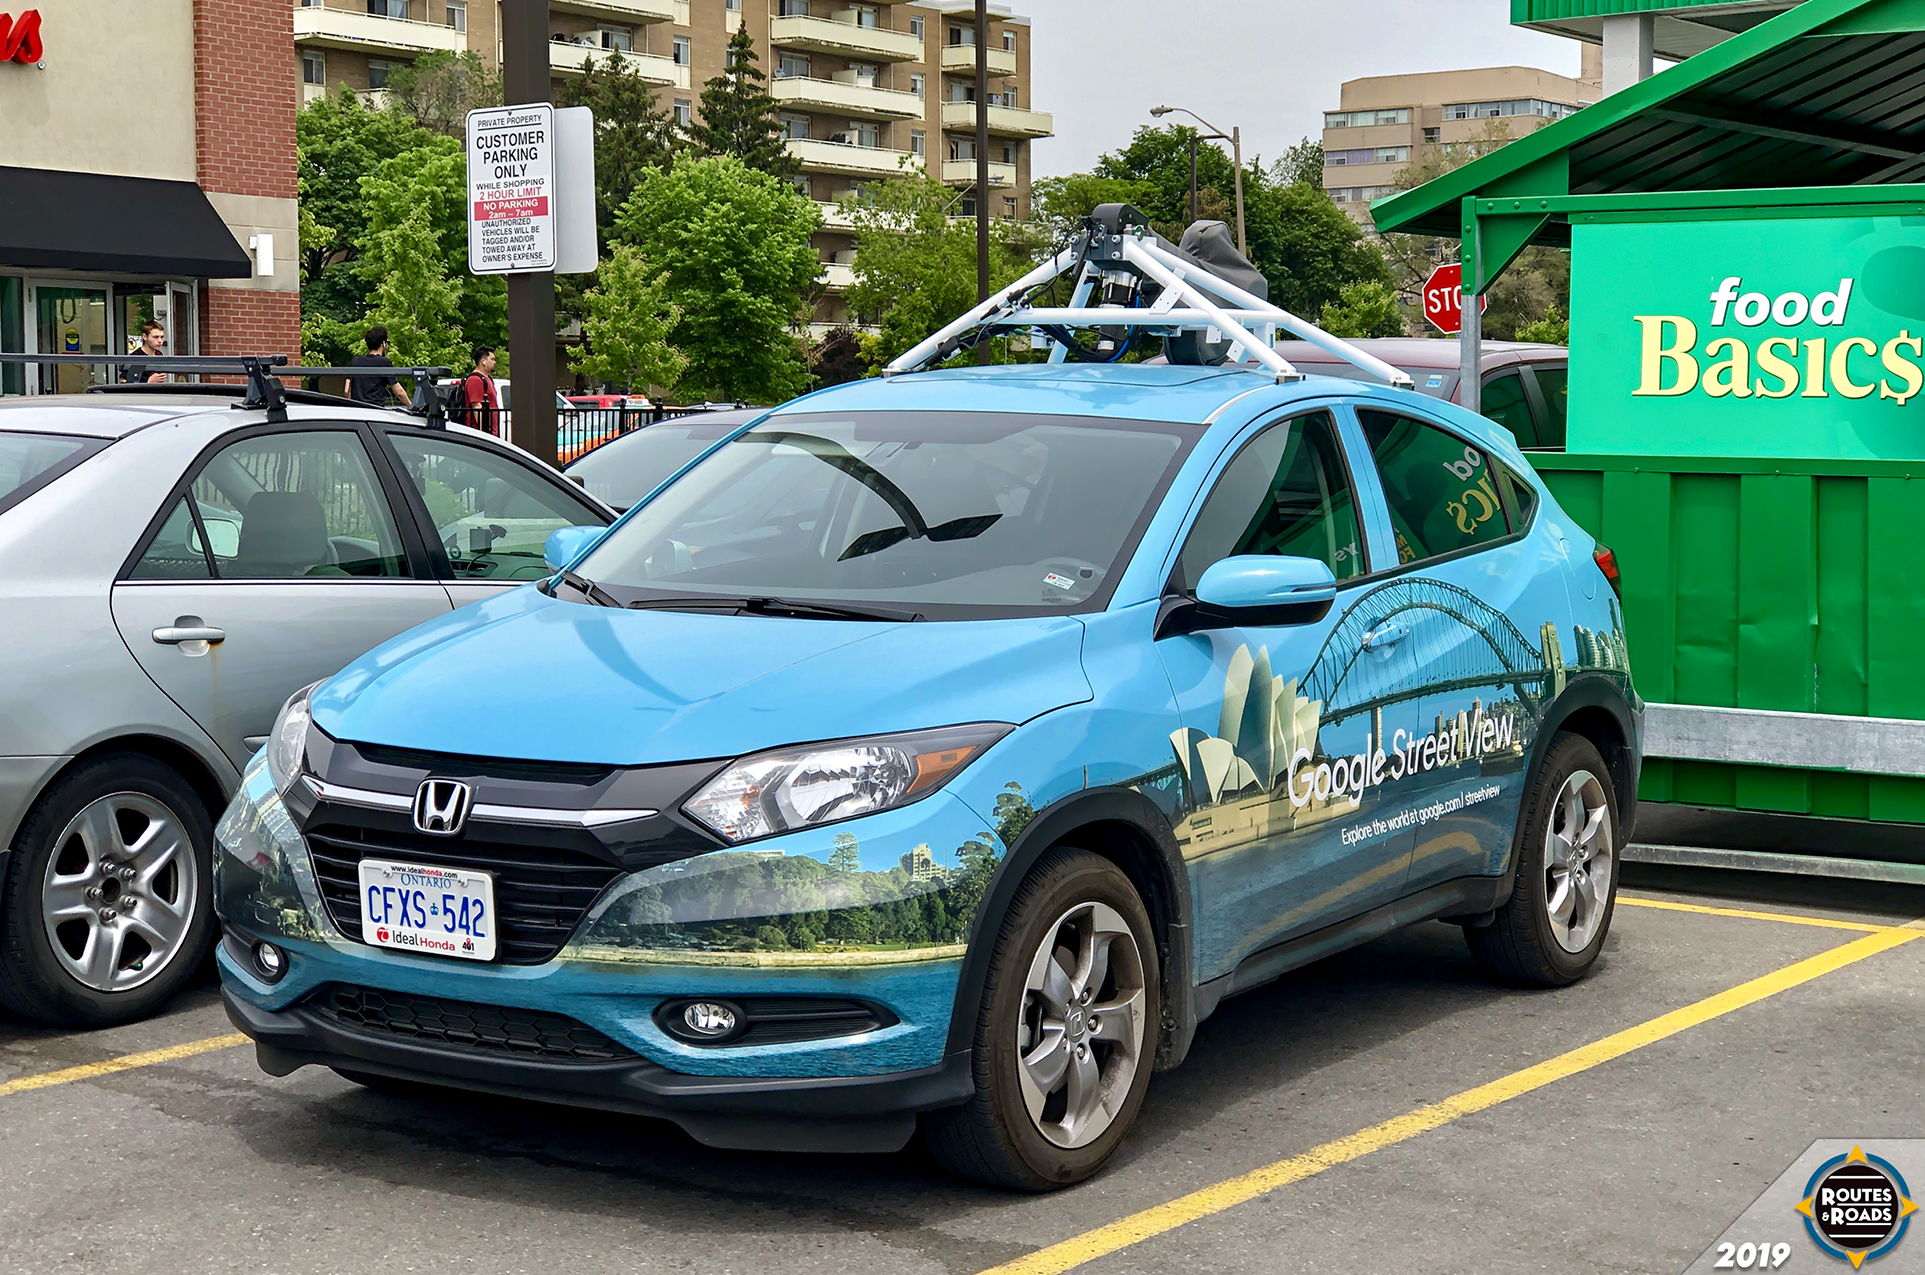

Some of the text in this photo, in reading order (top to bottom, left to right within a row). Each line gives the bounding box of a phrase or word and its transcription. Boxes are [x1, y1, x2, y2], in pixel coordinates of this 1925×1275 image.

[478, 115, 542, 127] PRIVATE PROPERTY
[476, 131, 544, 149] CUSTOMER
[484, 147, 538, 164] PARKING
[494, 164, 527, 179] ONLY
[476, 178, 544, 190] WHILE SHOPPING
[480, 187, 542, 200] 2 HOUR LIMIT
[483, 199, 538, 210] NO PARKING
[489, 211, 506, 219] 2am
[516, 209, 533, 217] 7am
[482, 218, 531, 228] UNAUTHORIZED
[482, 228, 512, 236] VEHICLES
[482, 235, 535, 245] TAGGED AND/OR
[482, 246, 505, 254] TOWED
[507, 244, 525, 252] AWAY
[482, 252, 542, 262] OWNER'S EXPENSE
[1428, 285, 1461, 313] STO
[1710, 276, 1855, 327] food
[1288, 708, 1513, 807] Google Street View
[1341, 826, 1373, 847] Explore
[1373, 820, 1388, 834] the
[1387, 810, 1410, 830] world
[1410, 811, 1419, 824] at
[391, 866, 458, 879] www.idealhonda.com
[401, 874, 451, 890] ONTARIO
[368, 885, 485, 937] CFXS 542
